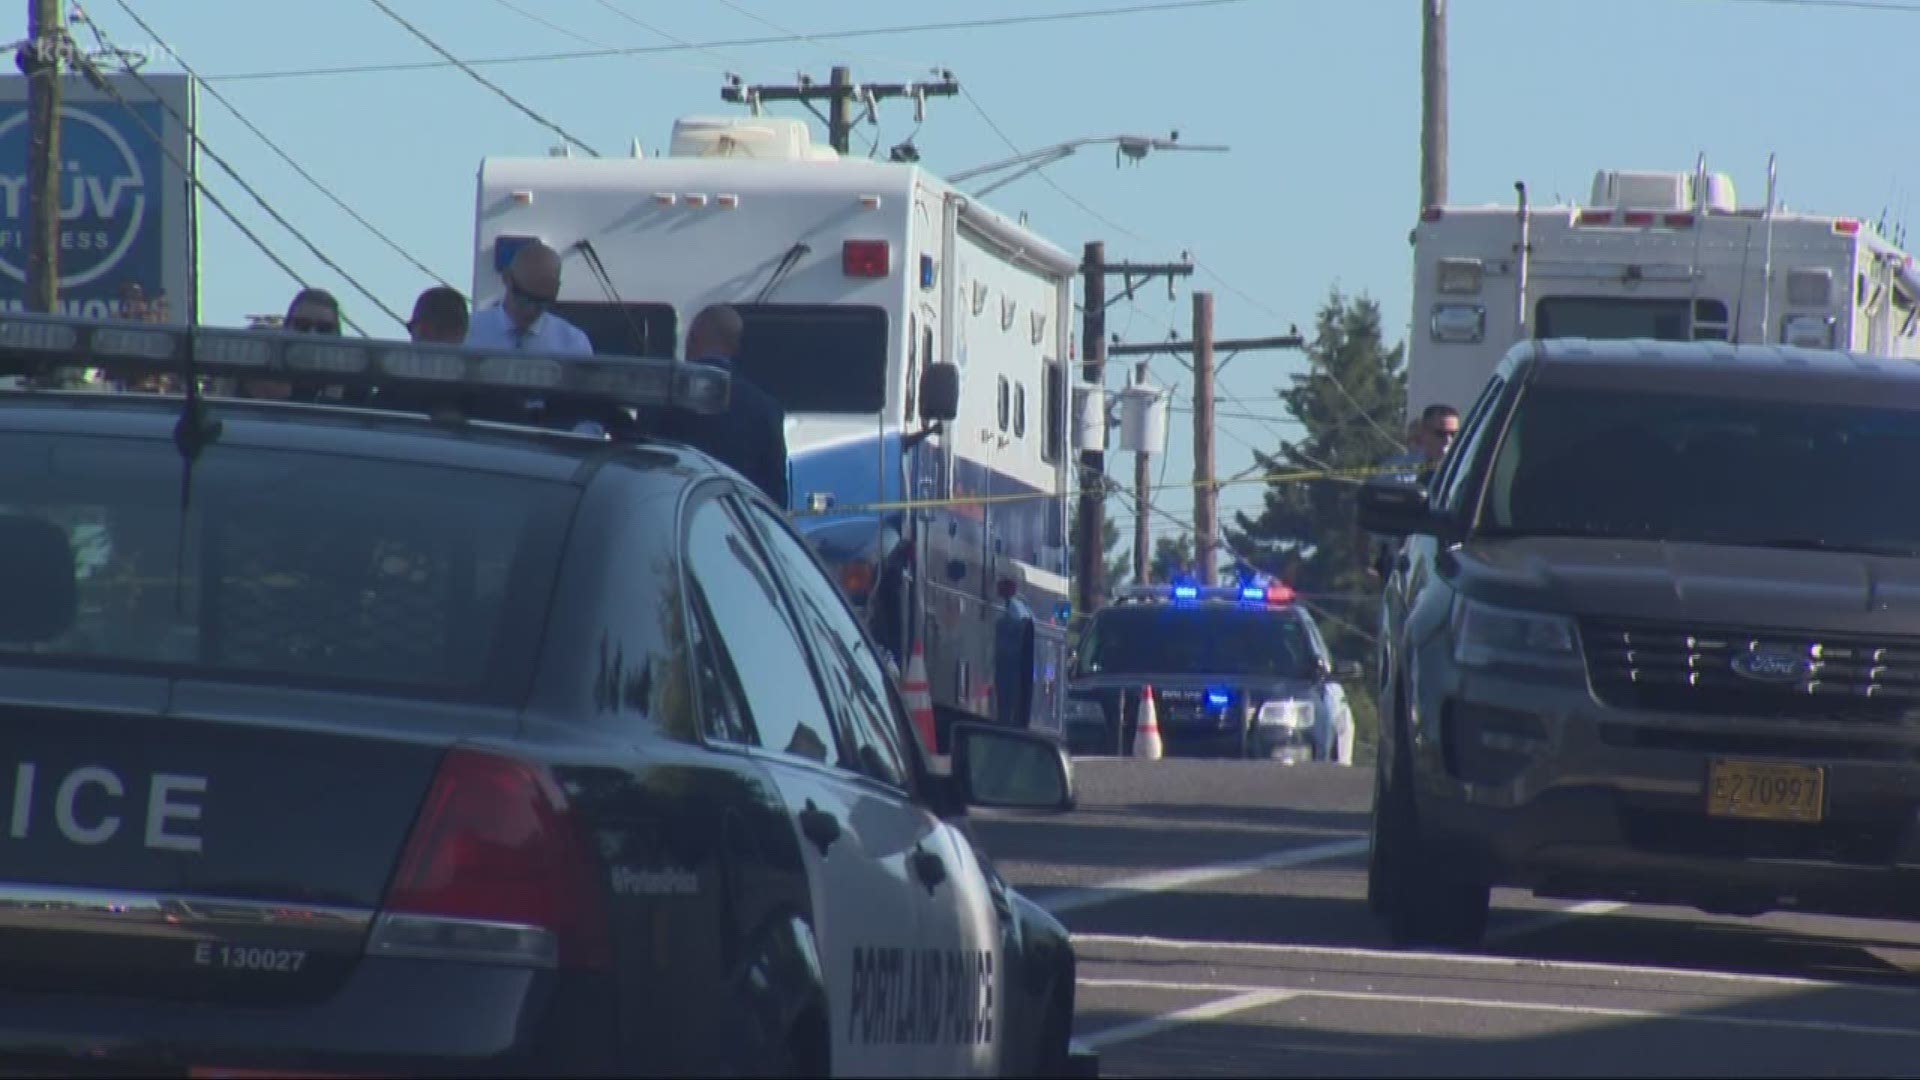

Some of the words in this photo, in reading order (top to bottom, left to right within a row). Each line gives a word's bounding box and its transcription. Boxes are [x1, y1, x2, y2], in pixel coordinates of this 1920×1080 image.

[1, 230, 108, 249] FIESS
[195, 942, 211, 965] E
[219, 946, 305, 972] 130027
[850, 947, 944, 1045] PORTLAND
[945, 949, 993, 1045] POLICE
